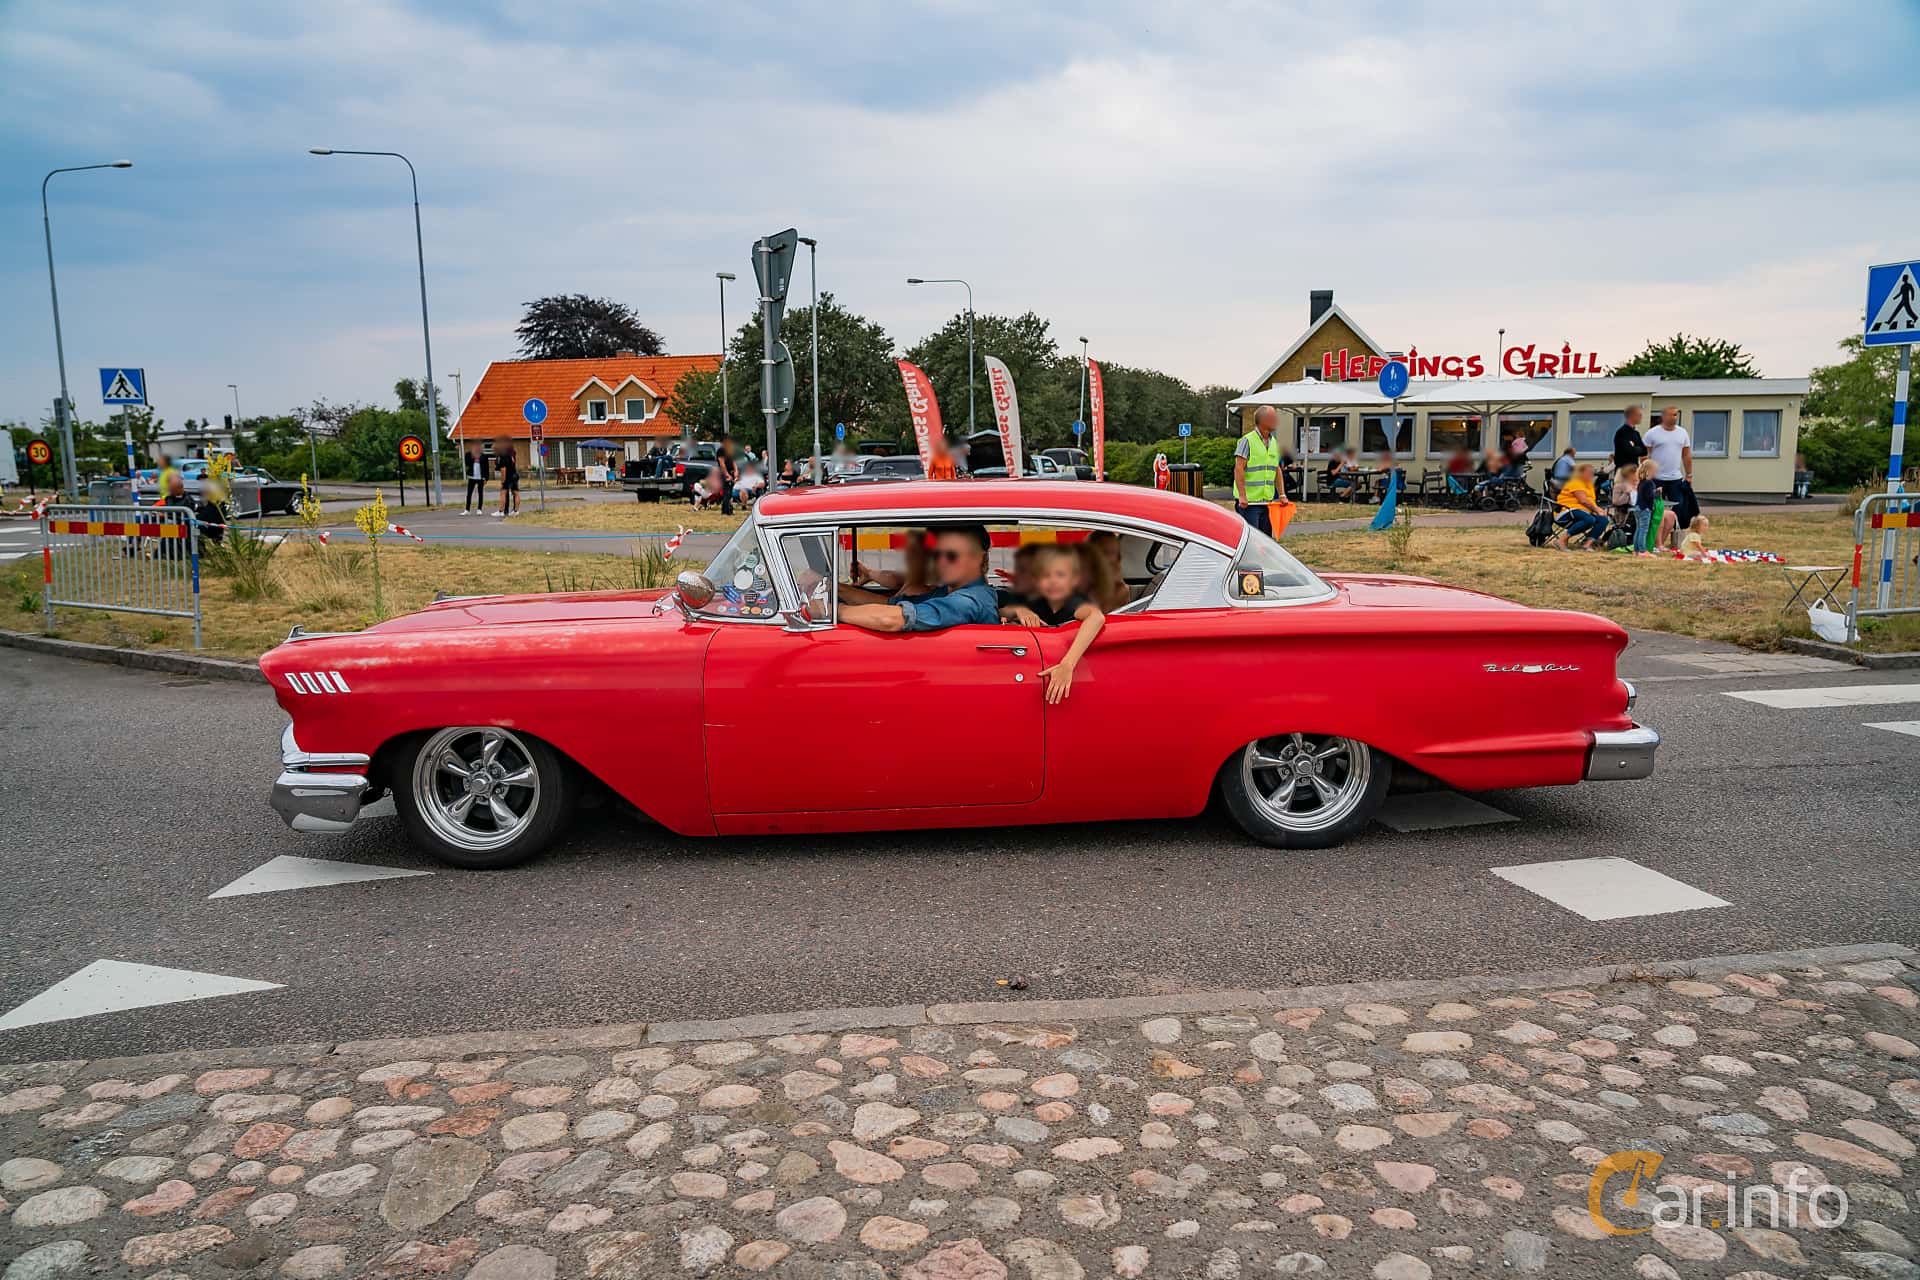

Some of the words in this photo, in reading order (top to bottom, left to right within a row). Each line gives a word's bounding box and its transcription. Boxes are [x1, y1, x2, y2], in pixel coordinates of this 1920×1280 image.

[32, 447, 48, 457] 30
[404, 443, 419, 454] 30
[1482, 663, 1521, 672] Bel
[1544, 663, 1580, 671] Air
